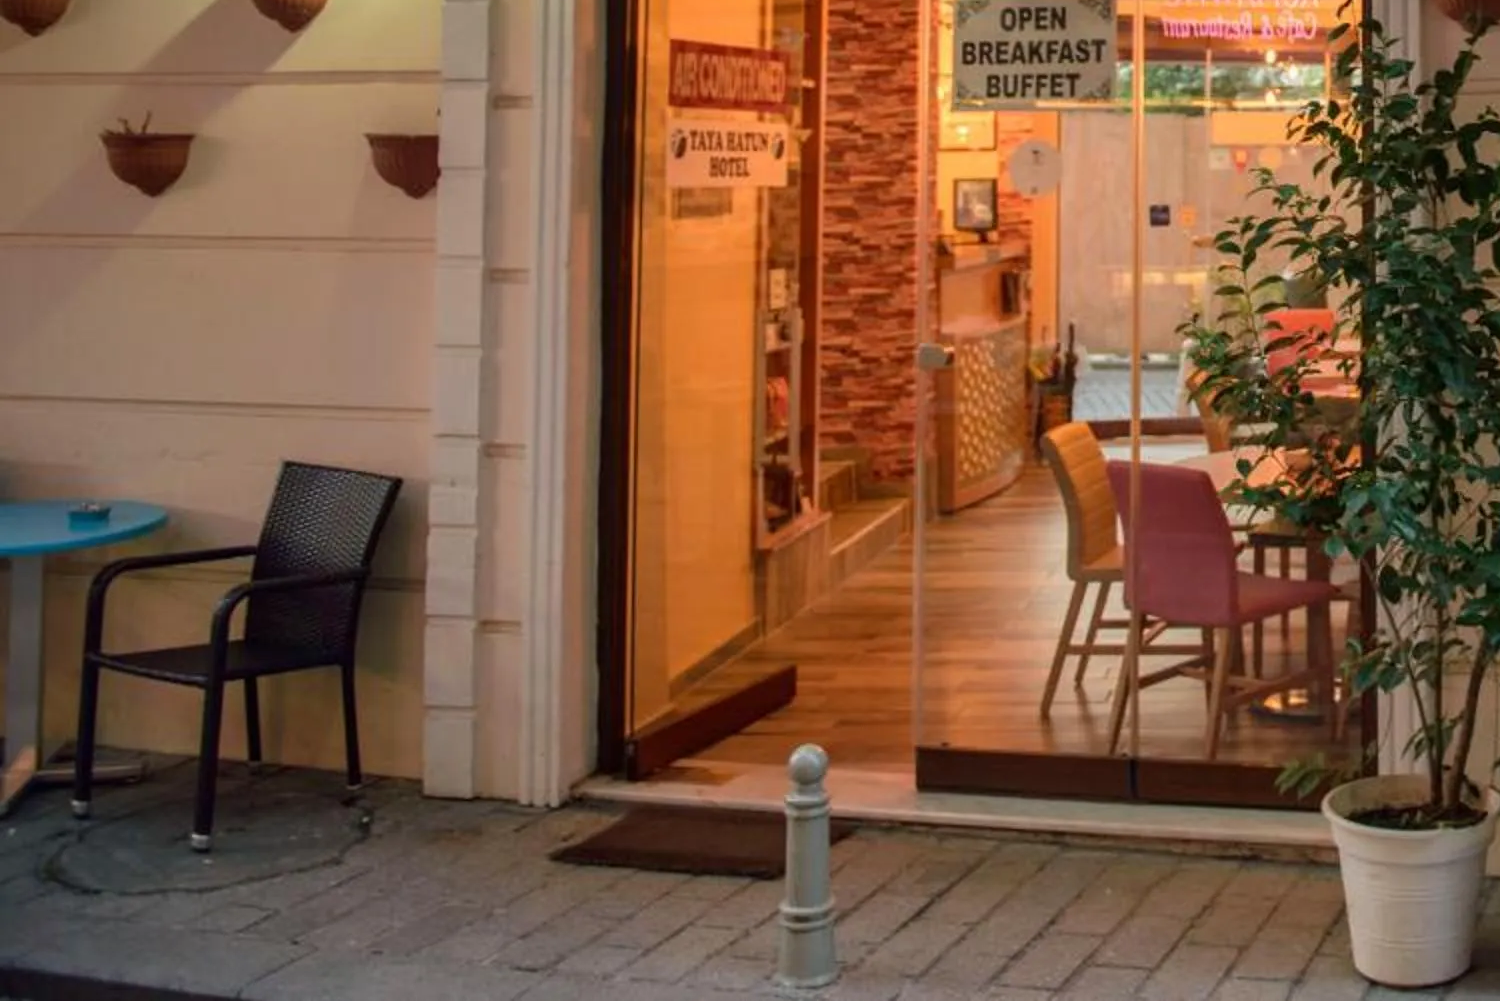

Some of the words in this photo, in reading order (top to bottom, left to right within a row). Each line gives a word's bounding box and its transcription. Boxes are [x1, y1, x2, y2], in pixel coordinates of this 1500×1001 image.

[1001, 7, 1067, 32] OPEN
[962, 39, 1107, 65] BREAKFAST
[986, 73, 1080, 98] BUFFET
[689, 130, 723, 151] TAYA
[726, 131, 769, 152] HATUN
[709, 157, 751, 178] HOTEL
